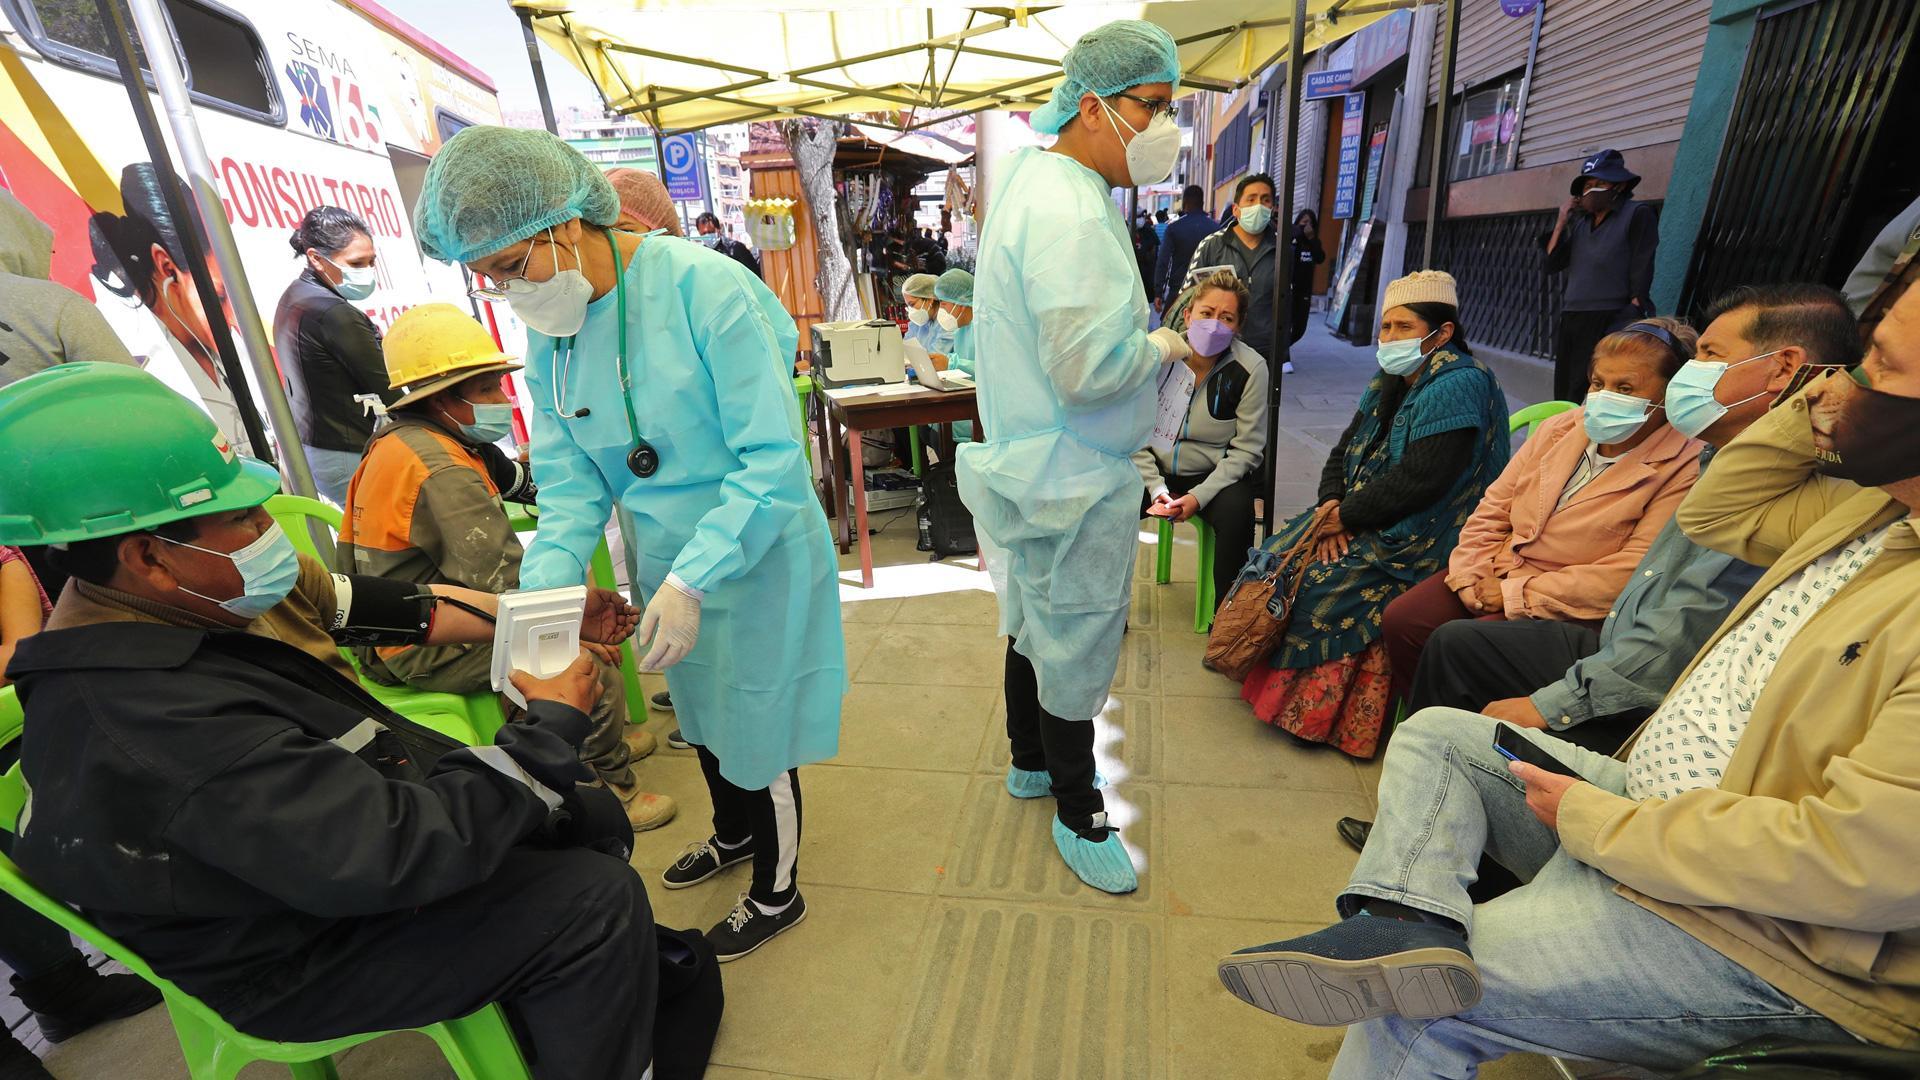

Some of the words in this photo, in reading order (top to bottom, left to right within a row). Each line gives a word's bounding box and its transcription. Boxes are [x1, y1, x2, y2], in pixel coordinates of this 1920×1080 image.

[287, 32, 357, 80] SEMA
[1311, 75, 1326, 85] CASA
[1326, 74, 1334, 84] DE
[1342, 135, 1359, 149] DOLAR
[670, 144, 685, 165] P
[1342, 149, 1356, 162] EURO
[1339, 162, 1356, 175] SOLES
[1335, 201, 1350, 214] REAL
